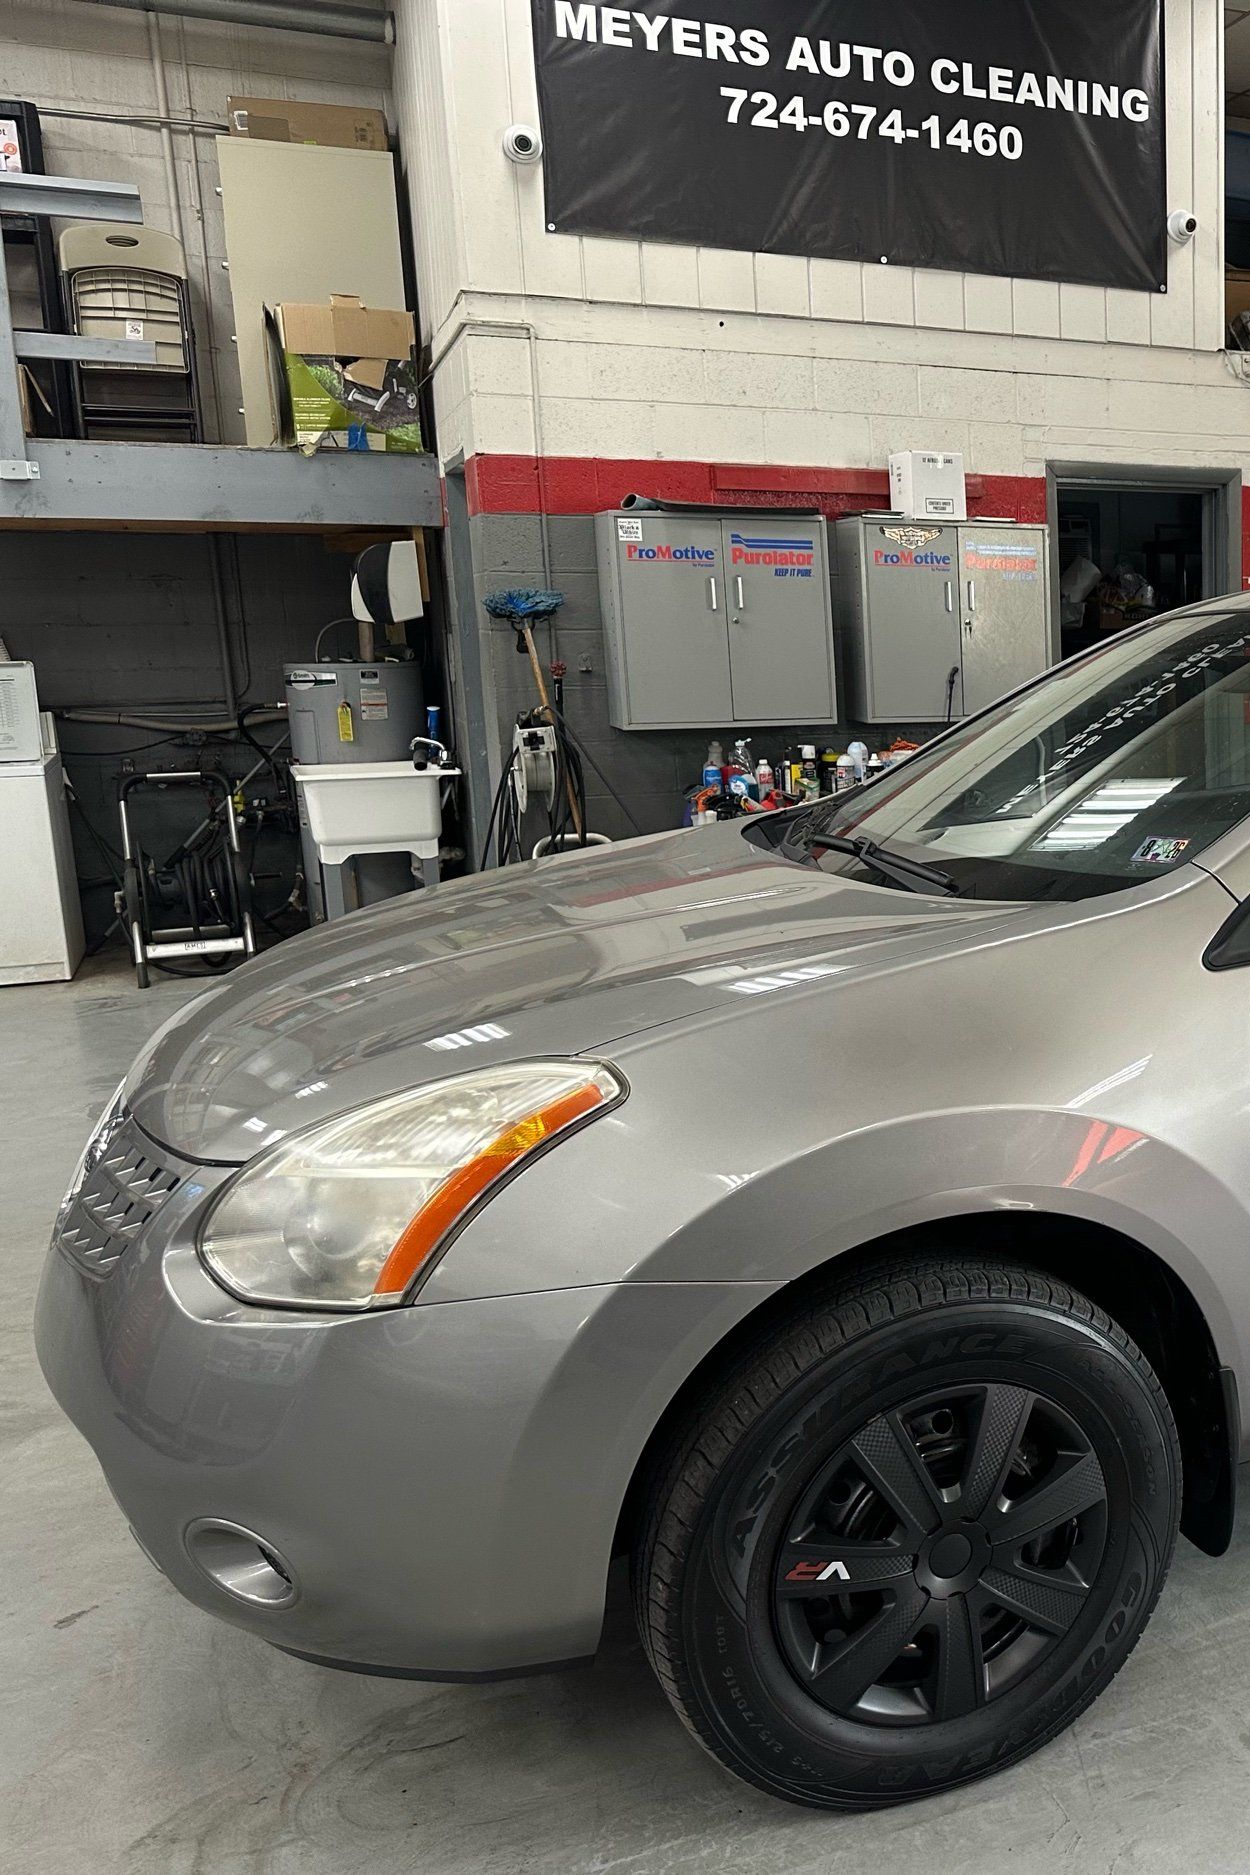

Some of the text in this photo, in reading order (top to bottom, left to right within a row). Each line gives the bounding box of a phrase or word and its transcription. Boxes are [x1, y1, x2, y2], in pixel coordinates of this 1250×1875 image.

[555, 0, 1149, 122] MEYERS AUTO CLEANING
[720, 87, 1023, 160] 724-674-1460
[627, 544, 715, 560] ProMotive
[731, 547, 814, 566] Purolator
[873, 550, 951, 566] ProMotive
[774, 568, 812, 577] KEEP IT PURE
[731, 1331, 1037, 1559] ASSURANCE
